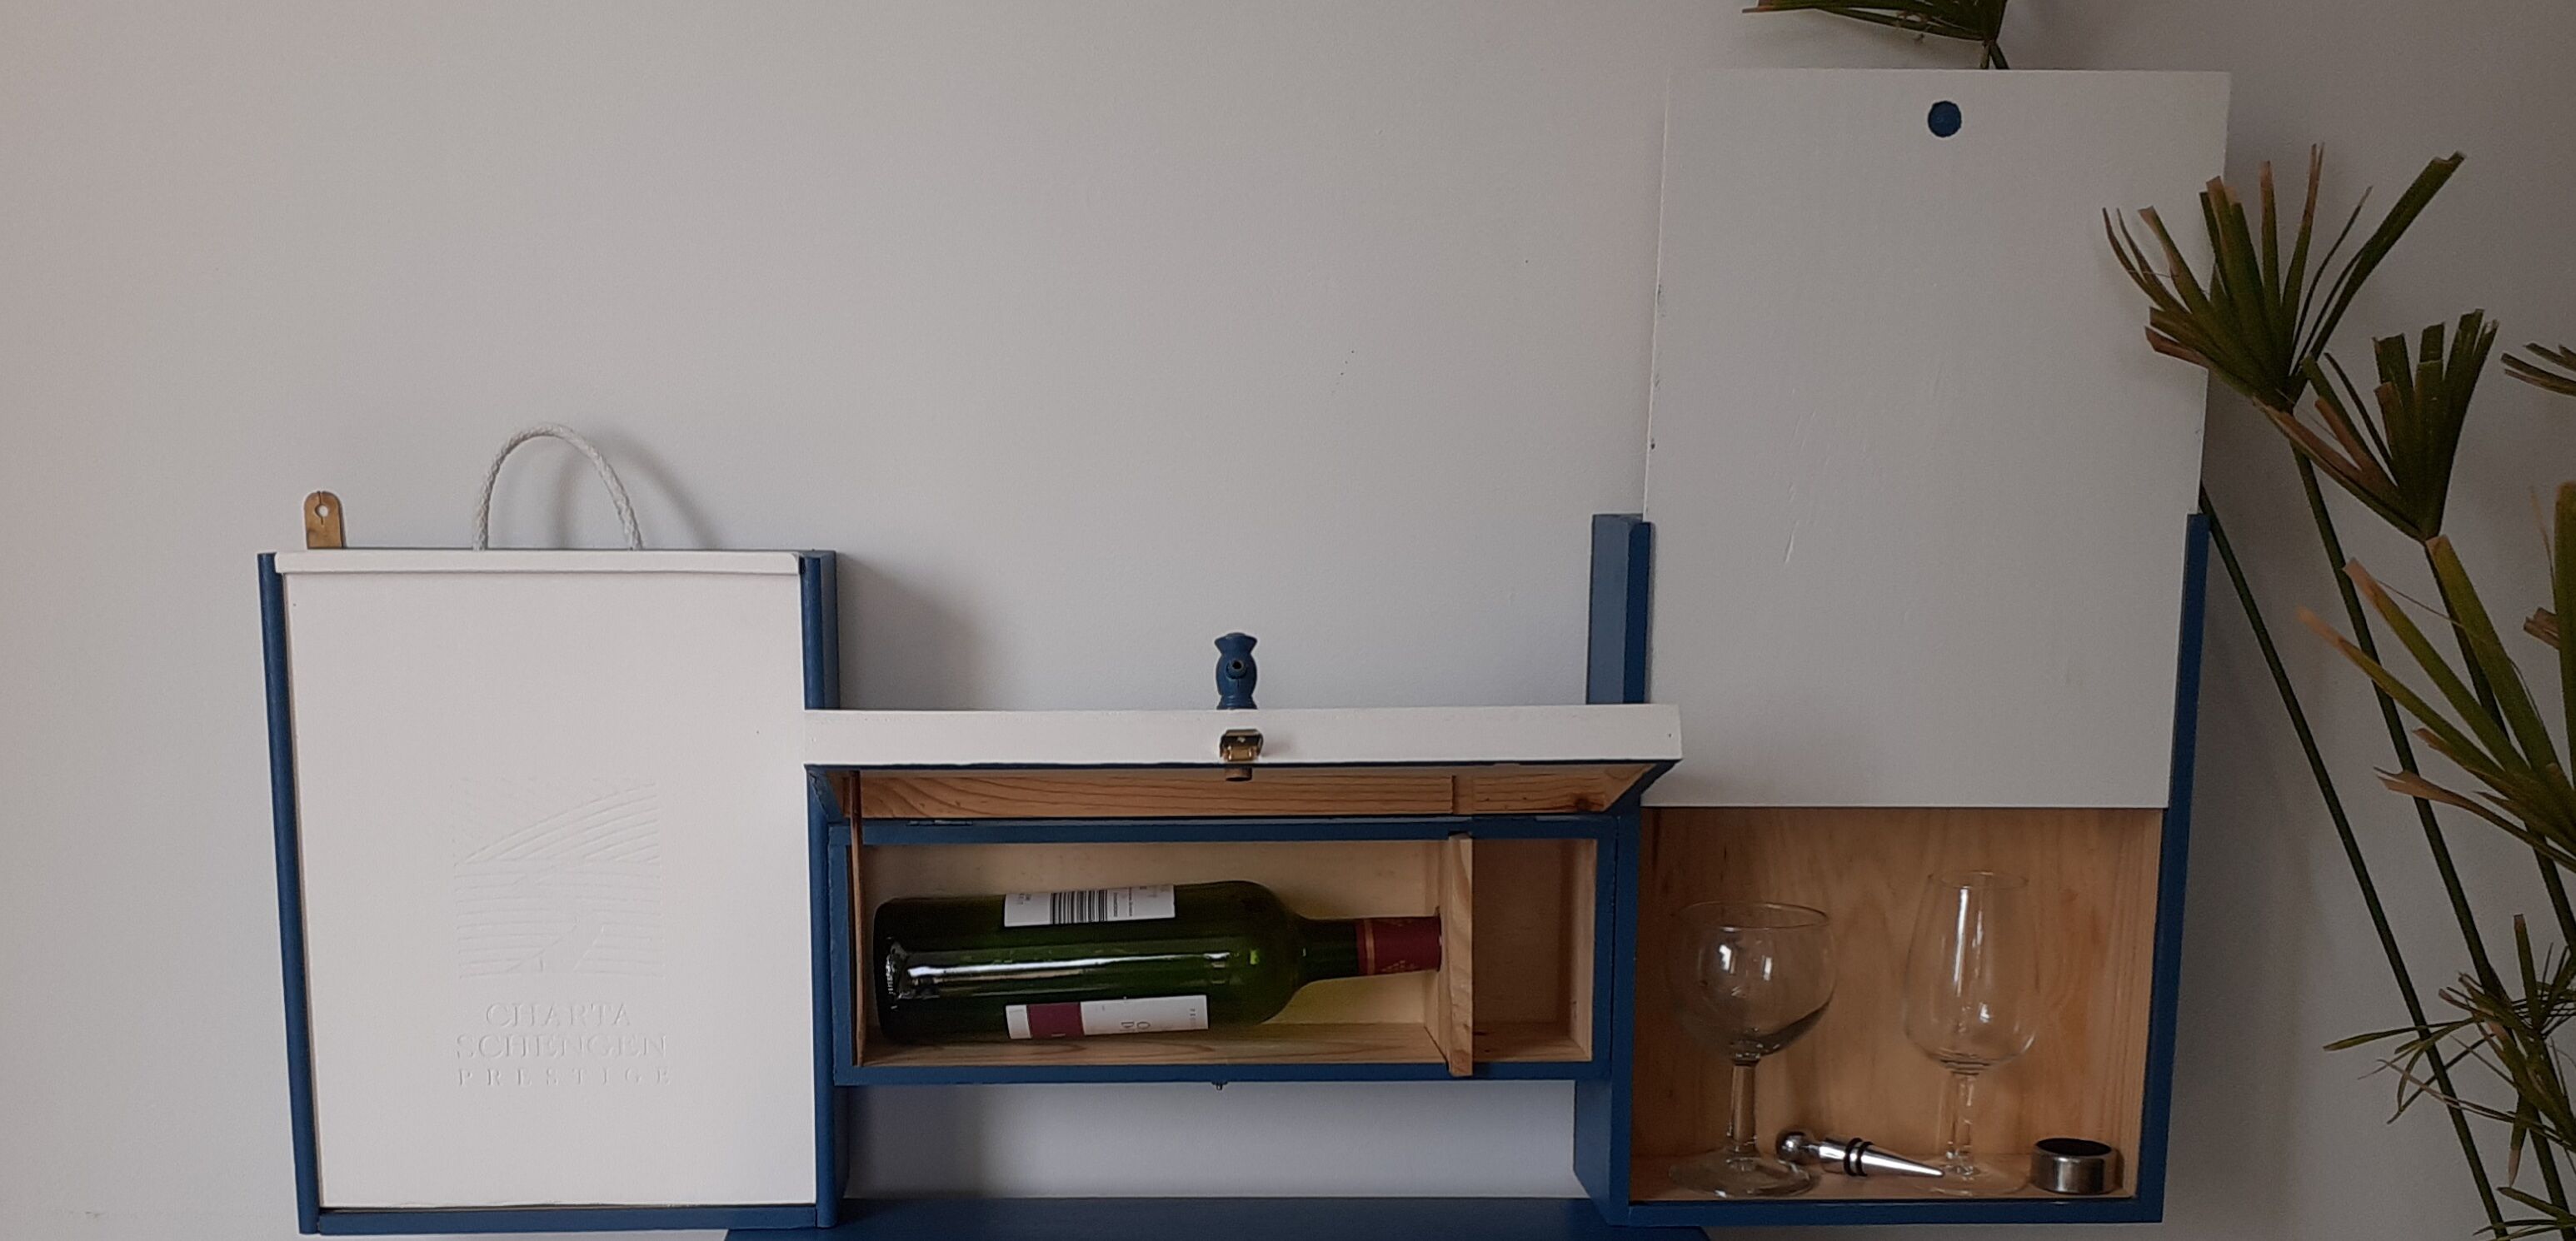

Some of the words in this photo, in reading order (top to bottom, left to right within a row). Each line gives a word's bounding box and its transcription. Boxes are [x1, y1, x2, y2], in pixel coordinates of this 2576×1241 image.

[487, 1002, 631, 1026] CHARTA
[456, 1034, 667, 1059] SCHENGEN
[458, 1067, 671, 1087] PRESTIGE
